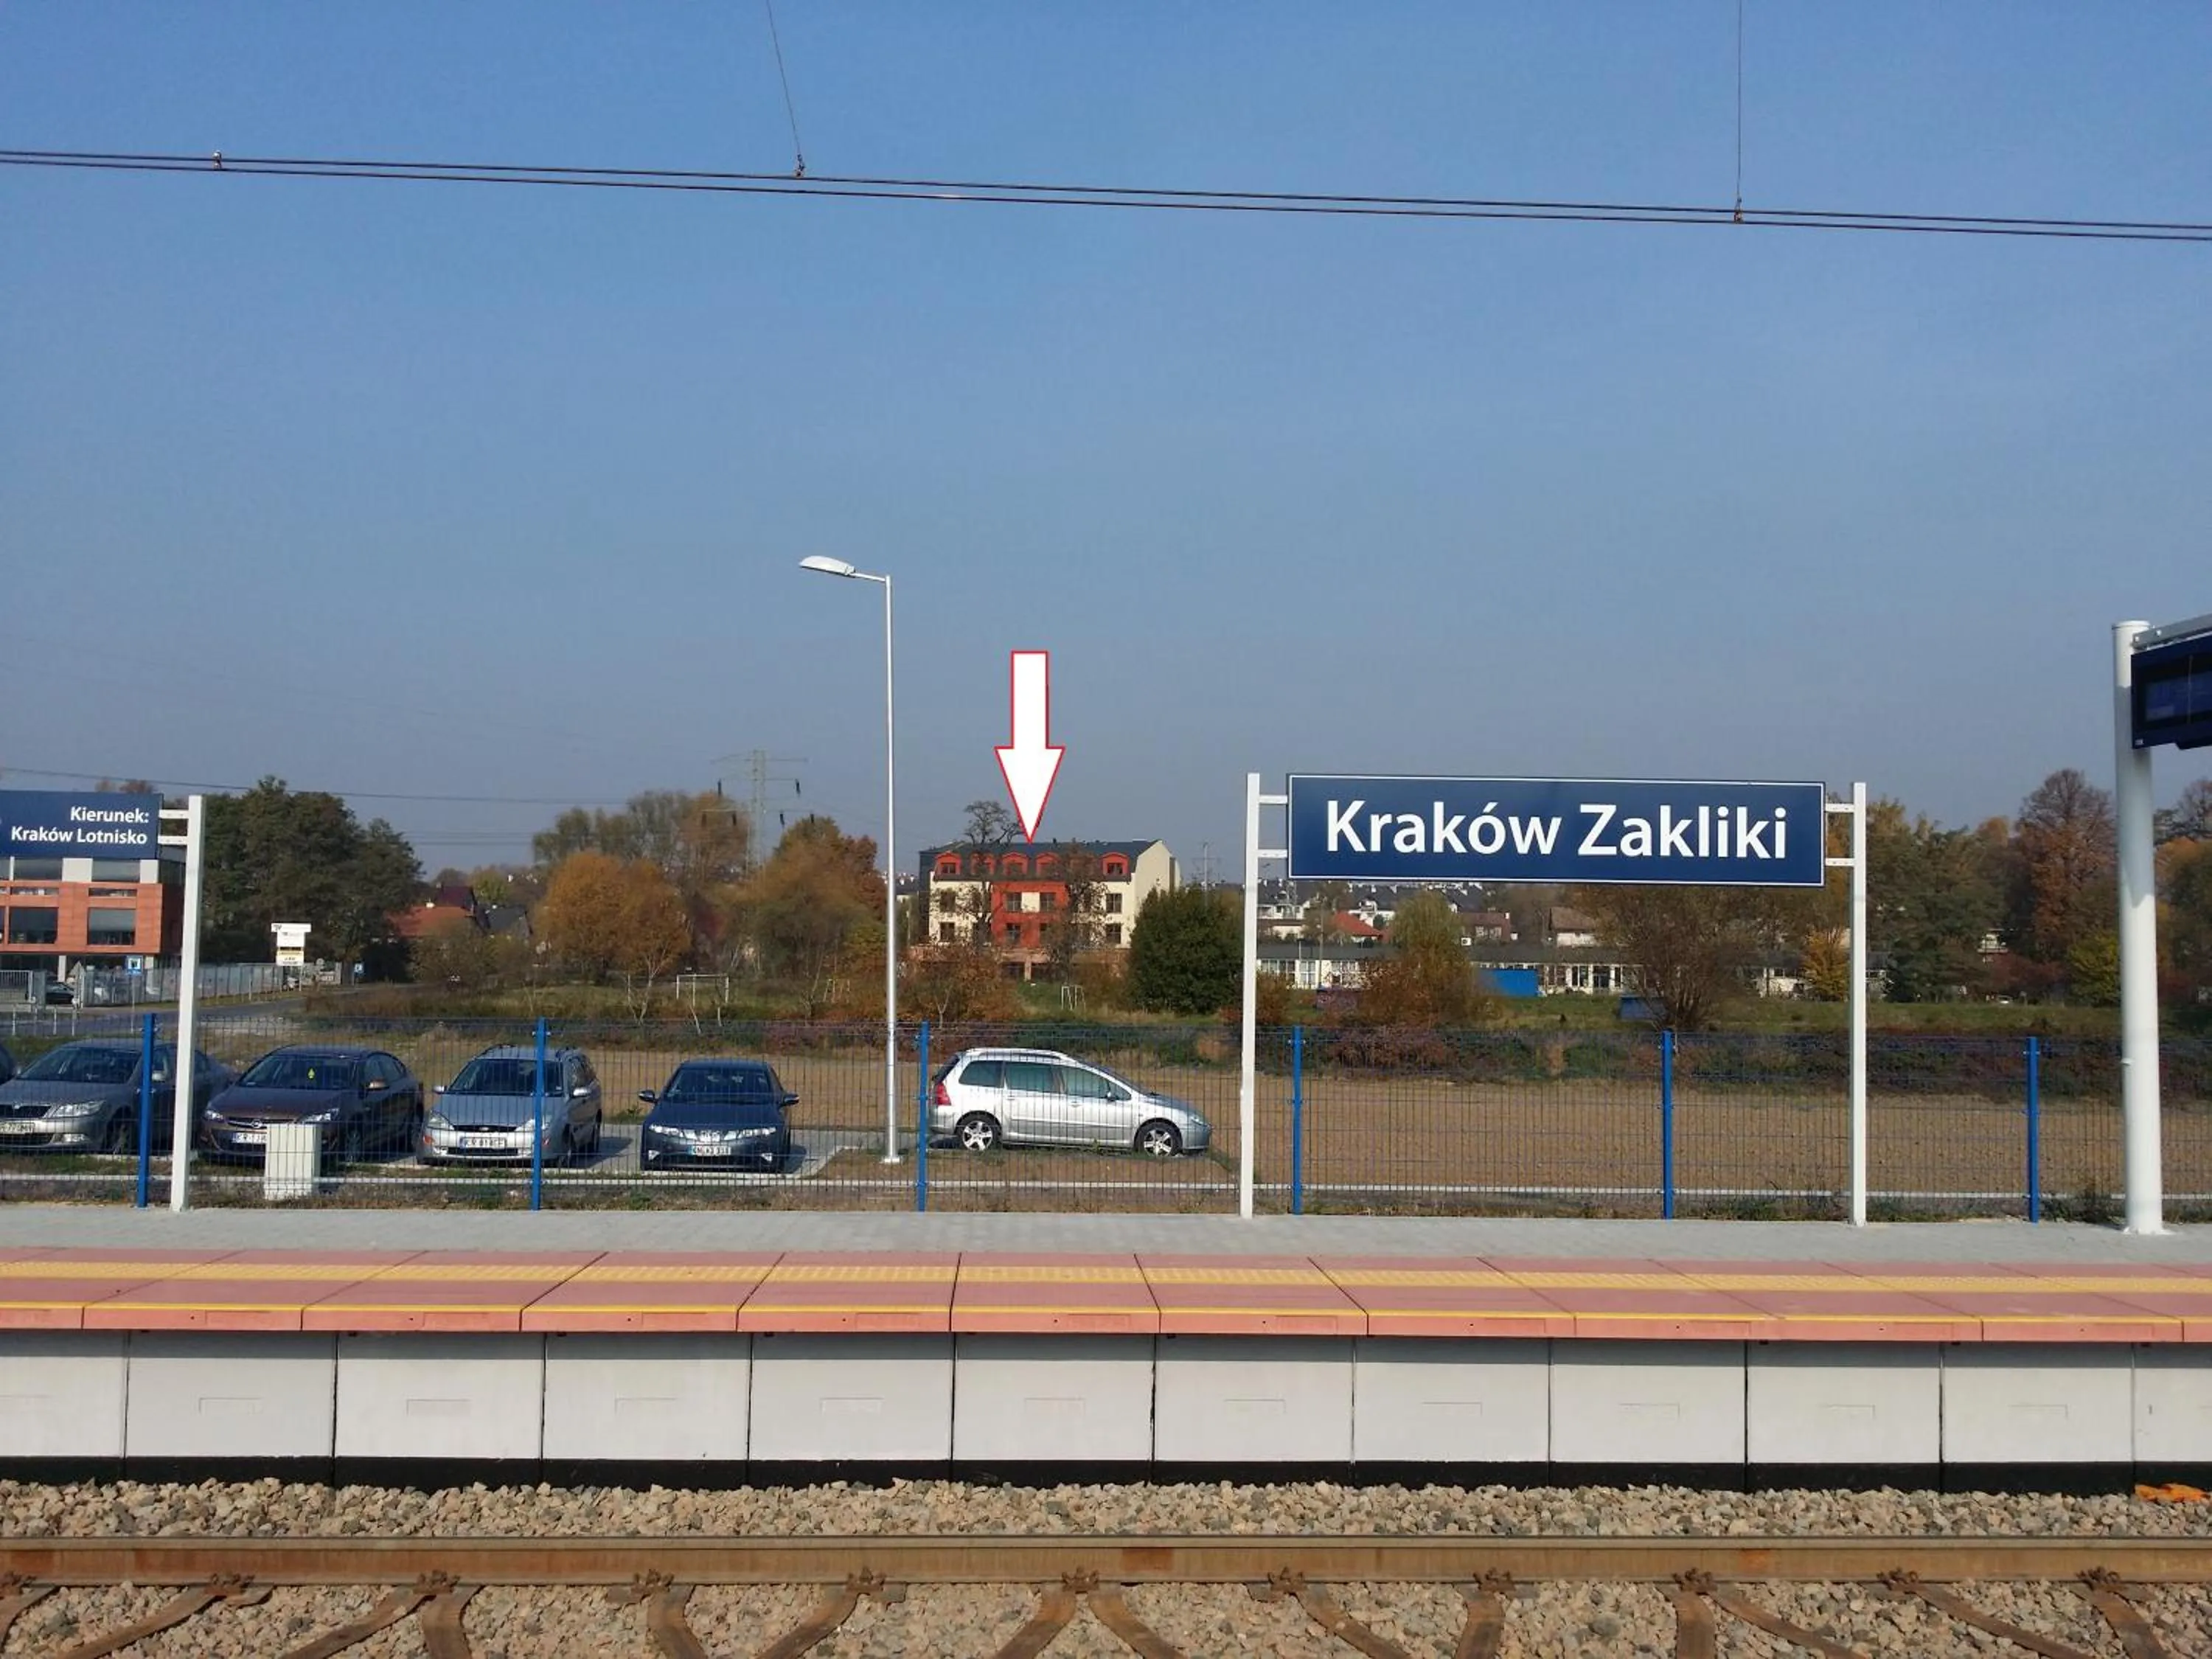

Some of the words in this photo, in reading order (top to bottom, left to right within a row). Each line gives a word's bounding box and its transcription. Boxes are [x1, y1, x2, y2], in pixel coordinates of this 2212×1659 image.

[70, 806, 149, 823] Kierunek:
[11, 826, 73, 842] Kraków
[77, 828, 147, 844] Lotnisko
[1327, 800, 1562, 855] Kraków
[1578, 804, 1788, 858] Zakliki
